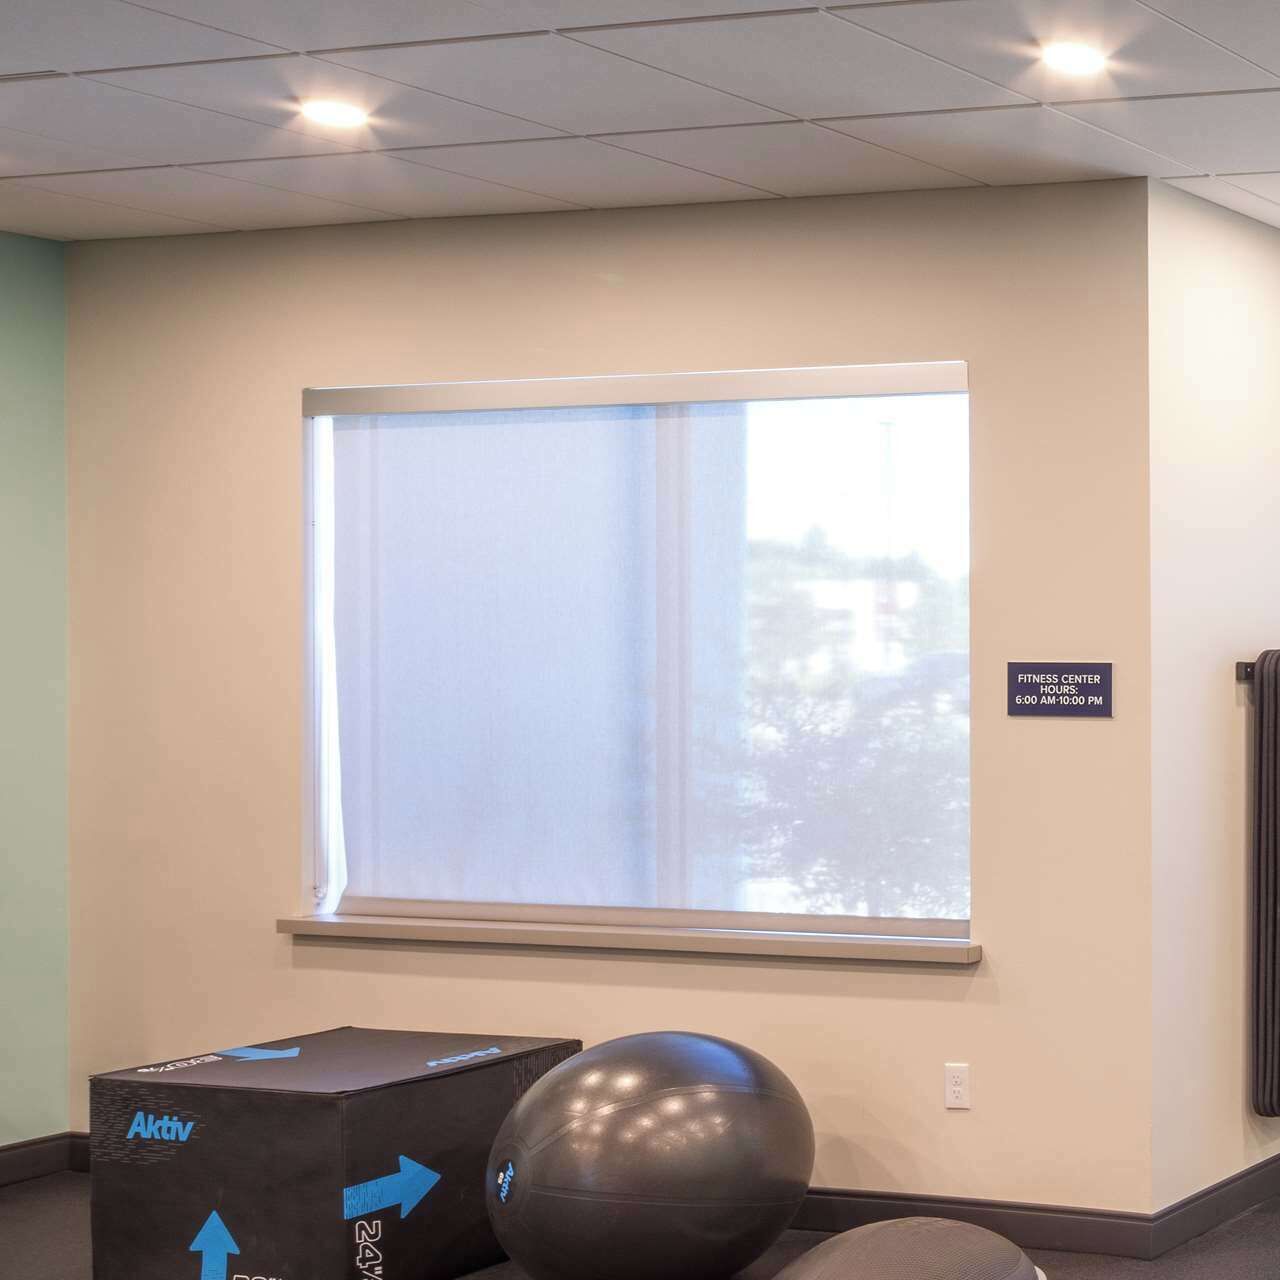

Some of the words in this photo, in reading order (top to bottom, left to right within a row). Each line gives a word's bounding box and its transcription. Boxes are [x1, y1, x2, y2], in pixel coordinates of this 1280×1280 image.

[1018, 674, 1058, 683] FITNESS
[1061, 674, 1100, 684] CENTER
[1040, 685, 1078, 694] HOURS:
[1015, 695, 1037, 704] 6:00
[1040, 696, 1085, 705] AM-10:00
[1088, 696, 1103, 705] PM
[126, 1111, 194, 1141] Aktiv
